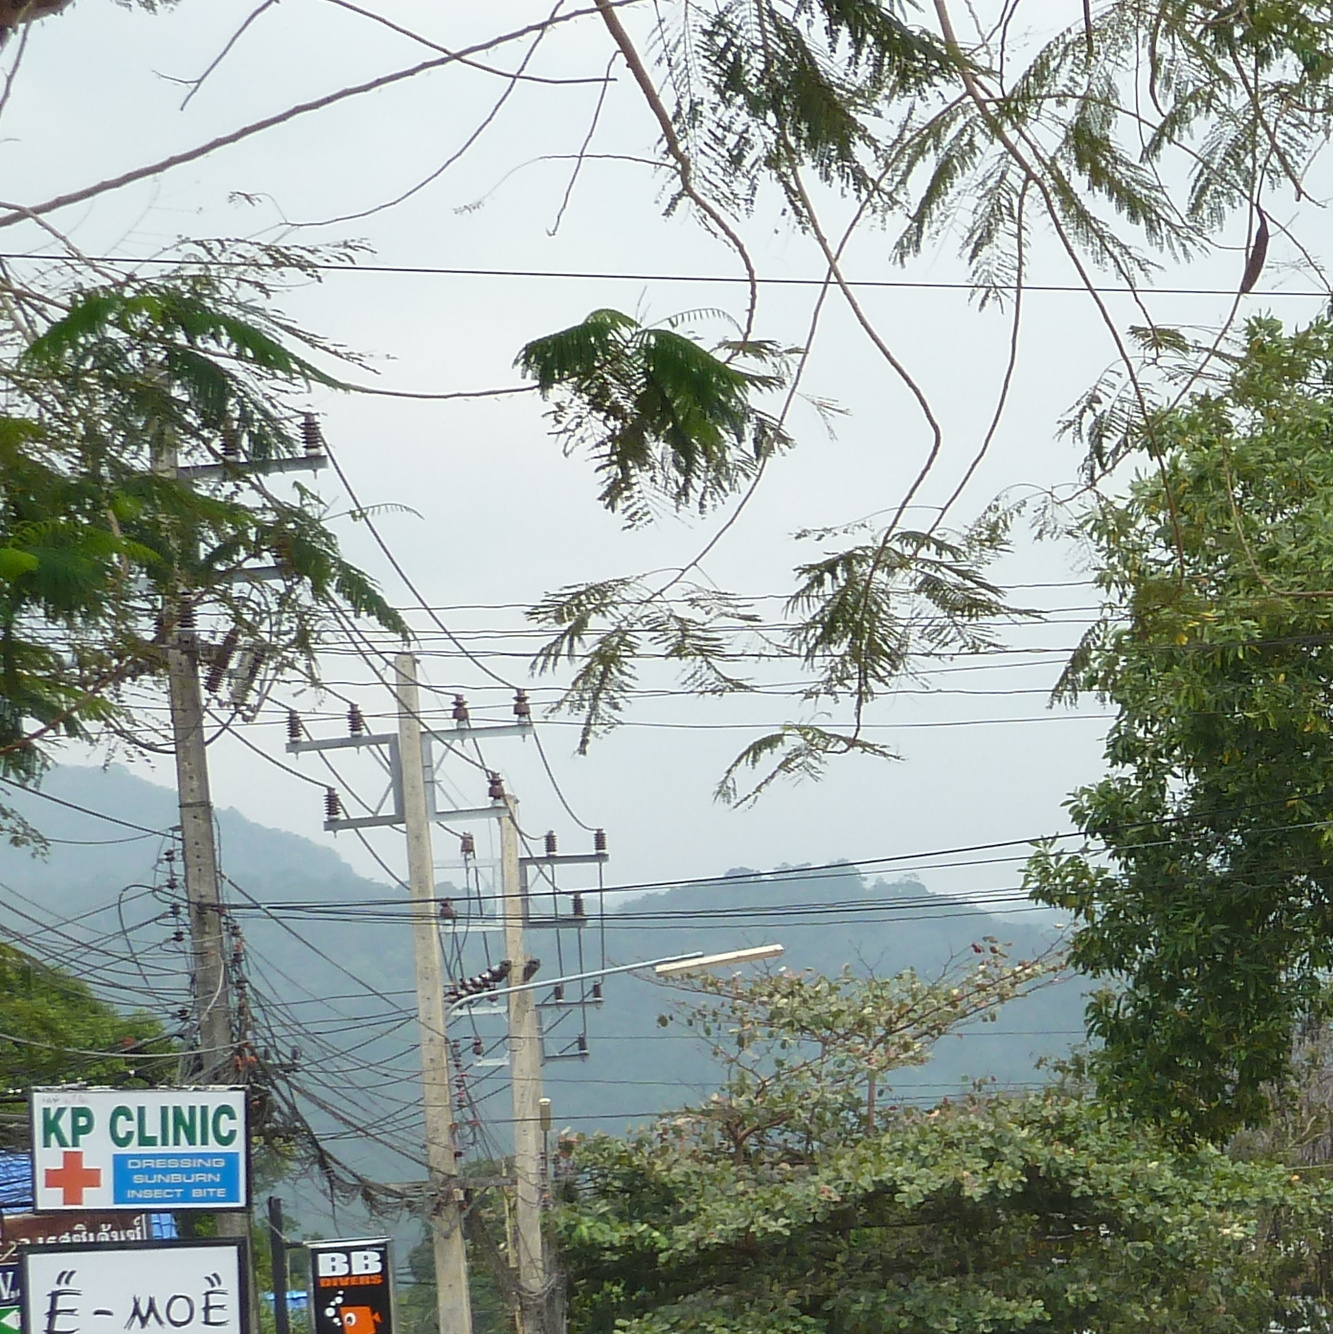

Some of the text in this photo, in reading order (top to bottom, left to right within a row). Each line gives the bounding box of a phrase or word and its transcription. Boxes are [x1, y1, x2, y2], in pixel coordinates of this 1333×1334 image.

[42, 1104, 238, 1149] KP CLINIC
[127, 1157, 226, 1170] DRESSING
[132, 1172, 221, 1184] SUNBURN
[126, 1187, 227, 1199] INSECT BITE
[317, 1250, 383, 1277] BB
[319, 1275, 383, 1288] DIVERS
